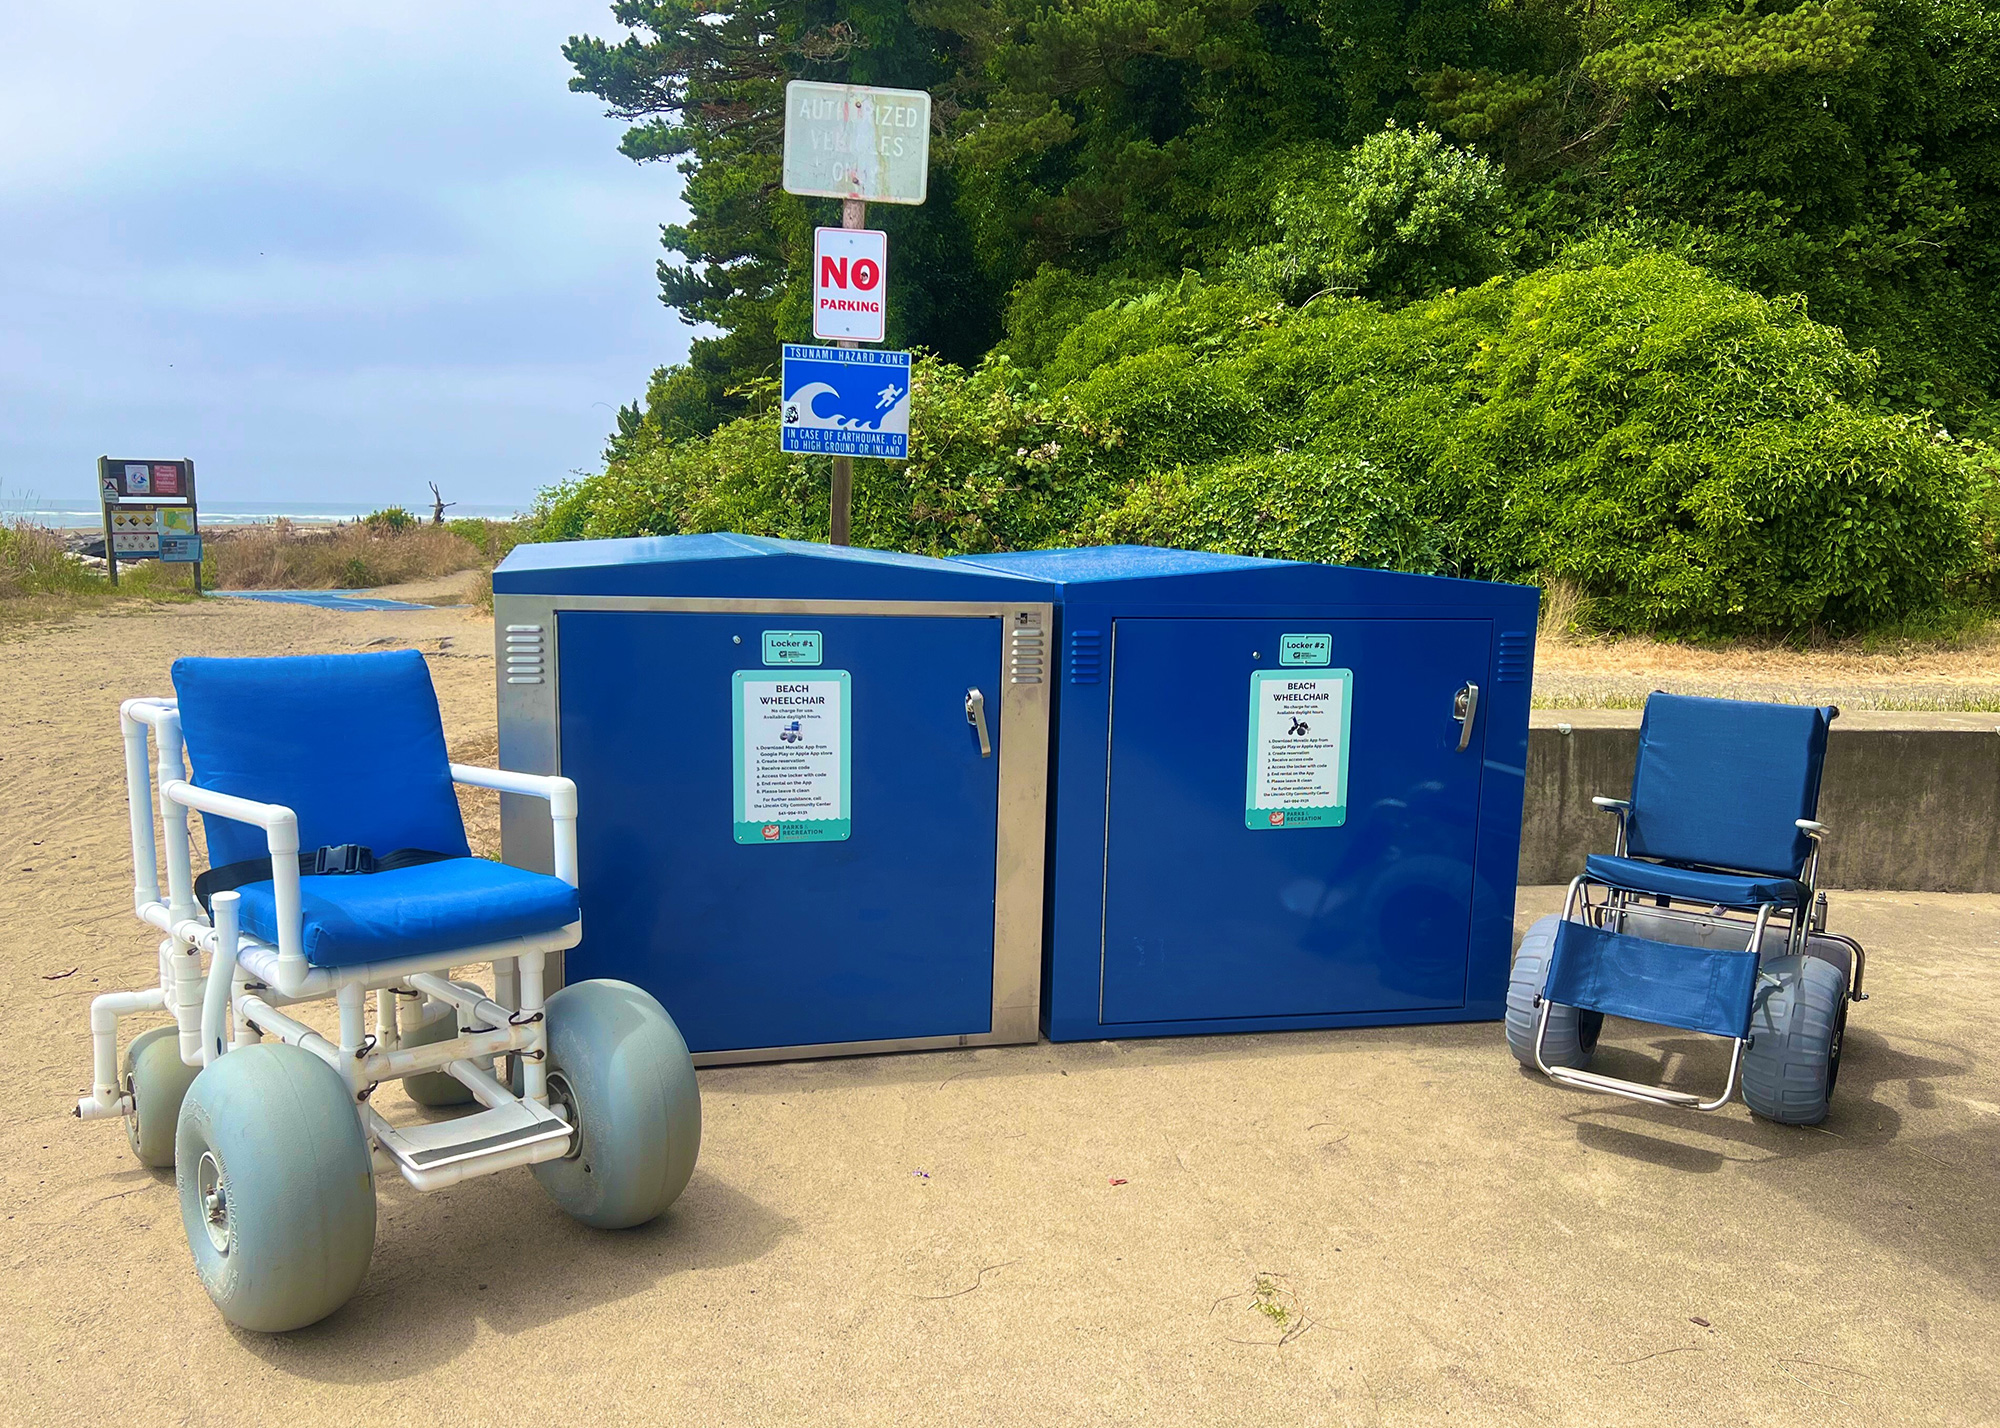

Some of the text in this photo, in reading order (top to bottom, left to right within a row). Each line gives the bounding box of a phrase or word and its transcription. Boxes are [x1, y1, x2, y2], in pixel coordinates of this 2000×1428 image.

[800, 99, 917, 127] AUTIZED
[821, 256, 879, 290] NO
[821, 299, 879, 312] PARKING
[791, 348, 904, 364] TSUNAMI HAZARD ZONE
[788, 429, 795, 438] IN
[800, 429, 819, 439] CASE
[824, 431, 833, 440] OF
[892, 435, 902, 445] GO
[791, 440, 899, 455] TO HIGH GROUND OR INLAND
